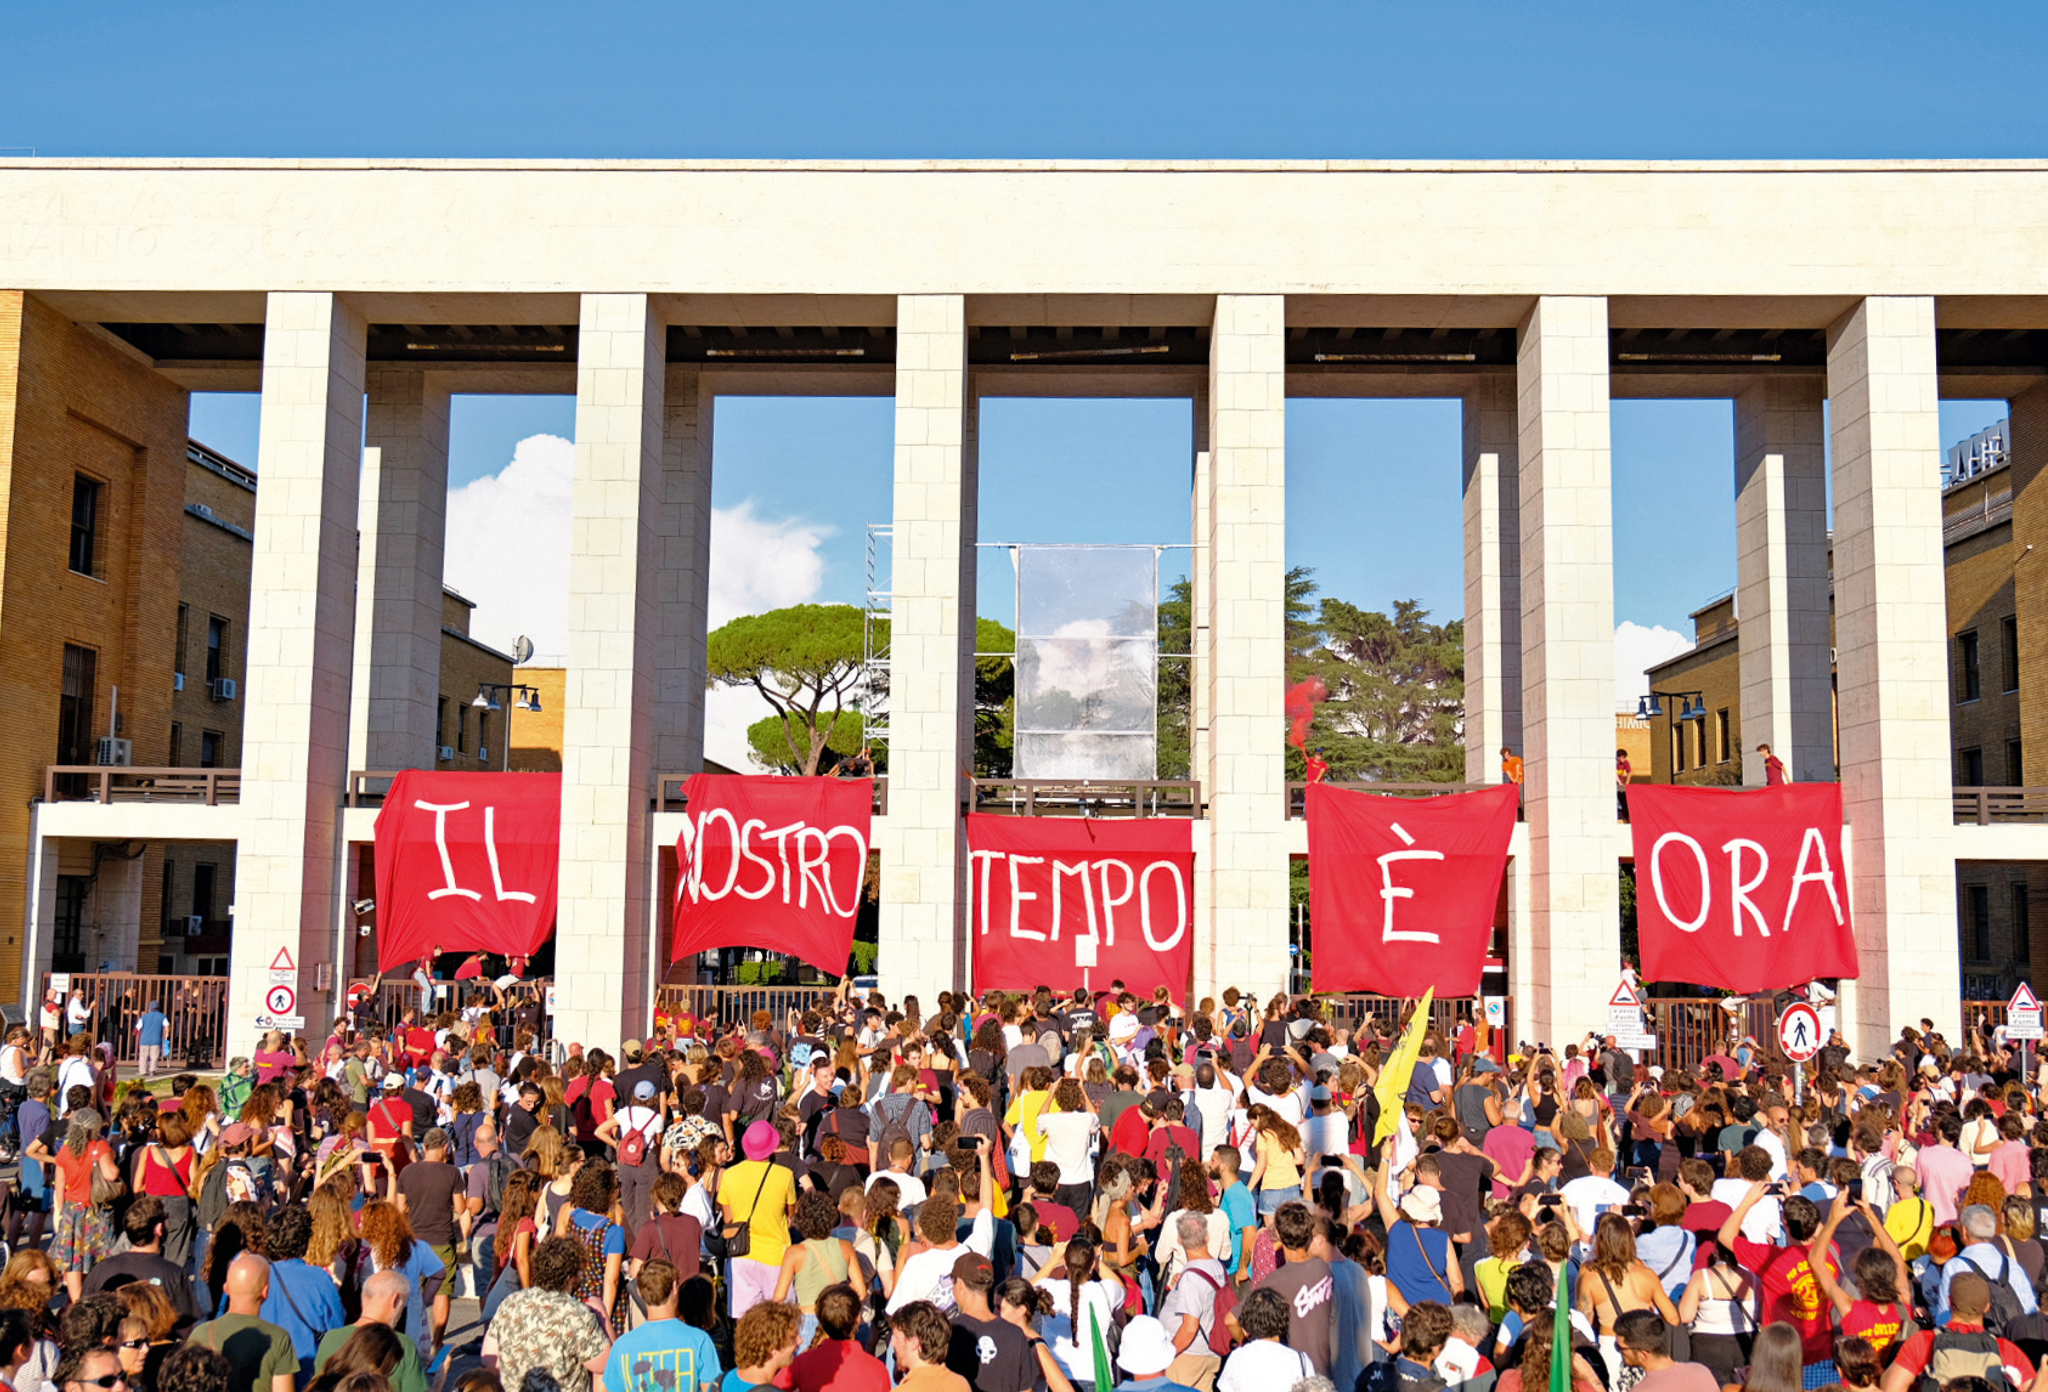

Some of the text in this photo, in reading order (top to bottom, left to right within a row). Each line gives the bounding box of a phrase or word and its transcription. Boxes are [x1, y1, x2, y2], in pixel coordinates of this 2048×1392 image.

[414, 799, 536, 905] IL
[677, 807, 868, 918] NOSTRO
[969, 849, 1187, 952] TEMPO
[1377, 822, 1445, 944] È
[1650, 827, 1845, 938] ORA
